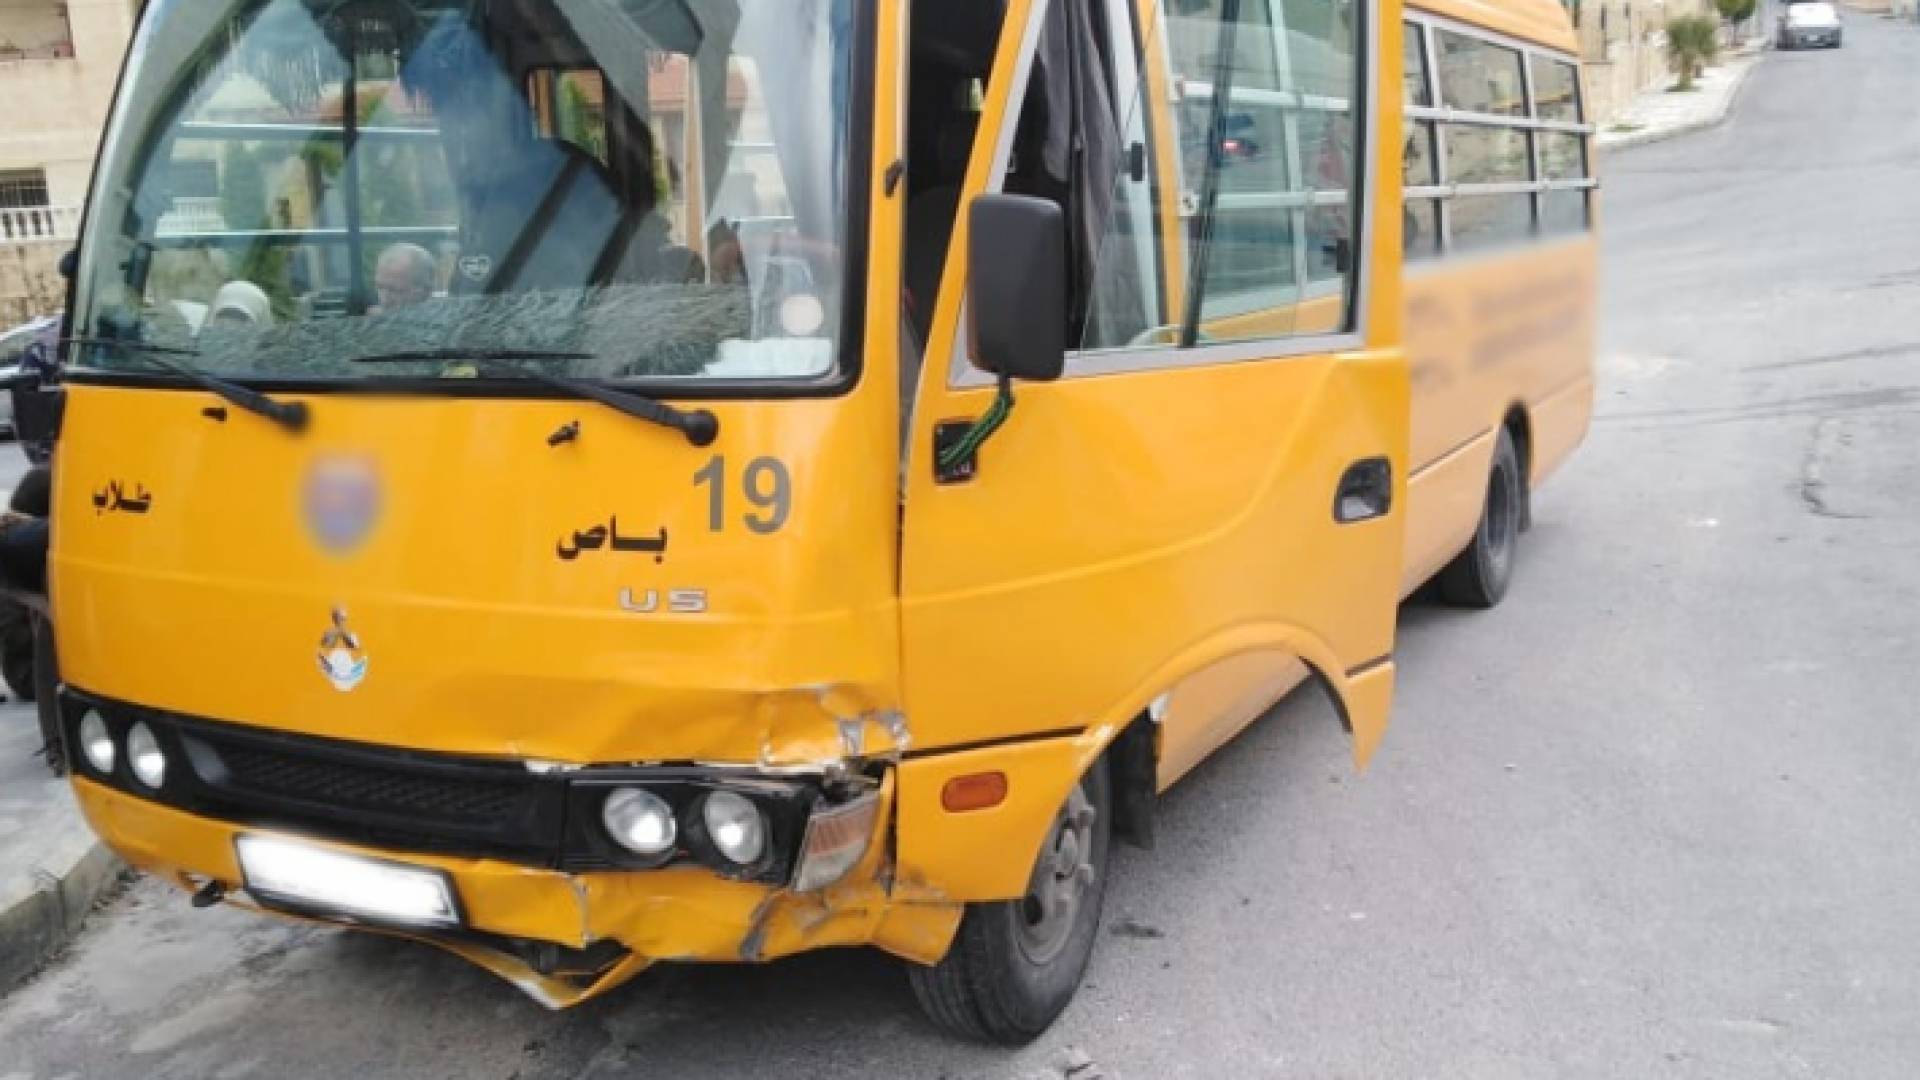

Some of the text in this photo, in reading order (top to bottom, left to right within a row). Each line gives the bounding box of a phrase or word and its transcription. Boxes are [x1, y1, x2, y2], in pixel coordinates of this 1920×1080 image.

[92, 480, 668, 563] باص طلاب
[692, 454, 792, 535] 19
[619, 587, 708, 614] US
